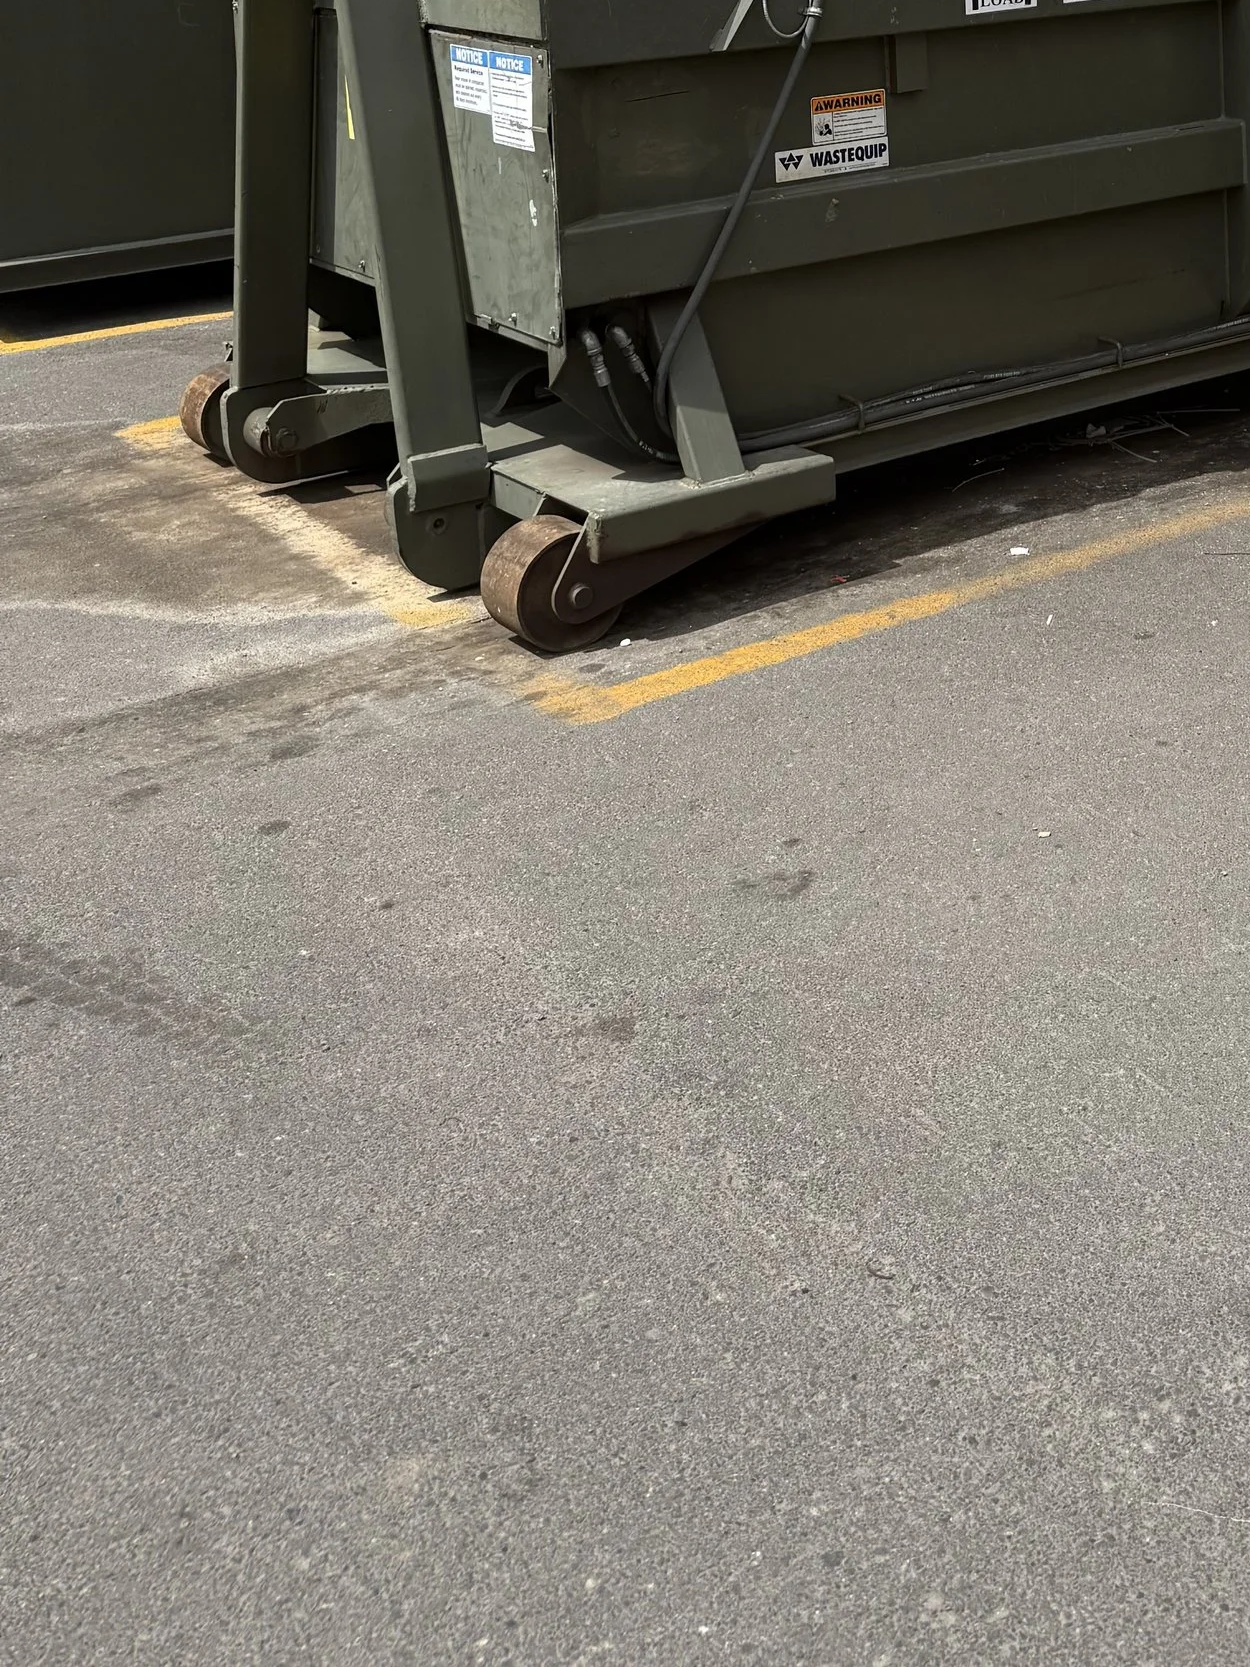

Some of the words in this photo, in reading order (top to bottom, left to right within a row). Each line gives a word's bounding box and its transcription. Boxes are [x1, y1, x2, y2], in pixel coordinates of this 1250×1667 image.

[456, 48, 483, 64] NOTICE
[496, 57, 524, 71] NOTICE
[823, 94, 881, 111] WARNING
[810, 143, 887, 168] WASTEQUIP
